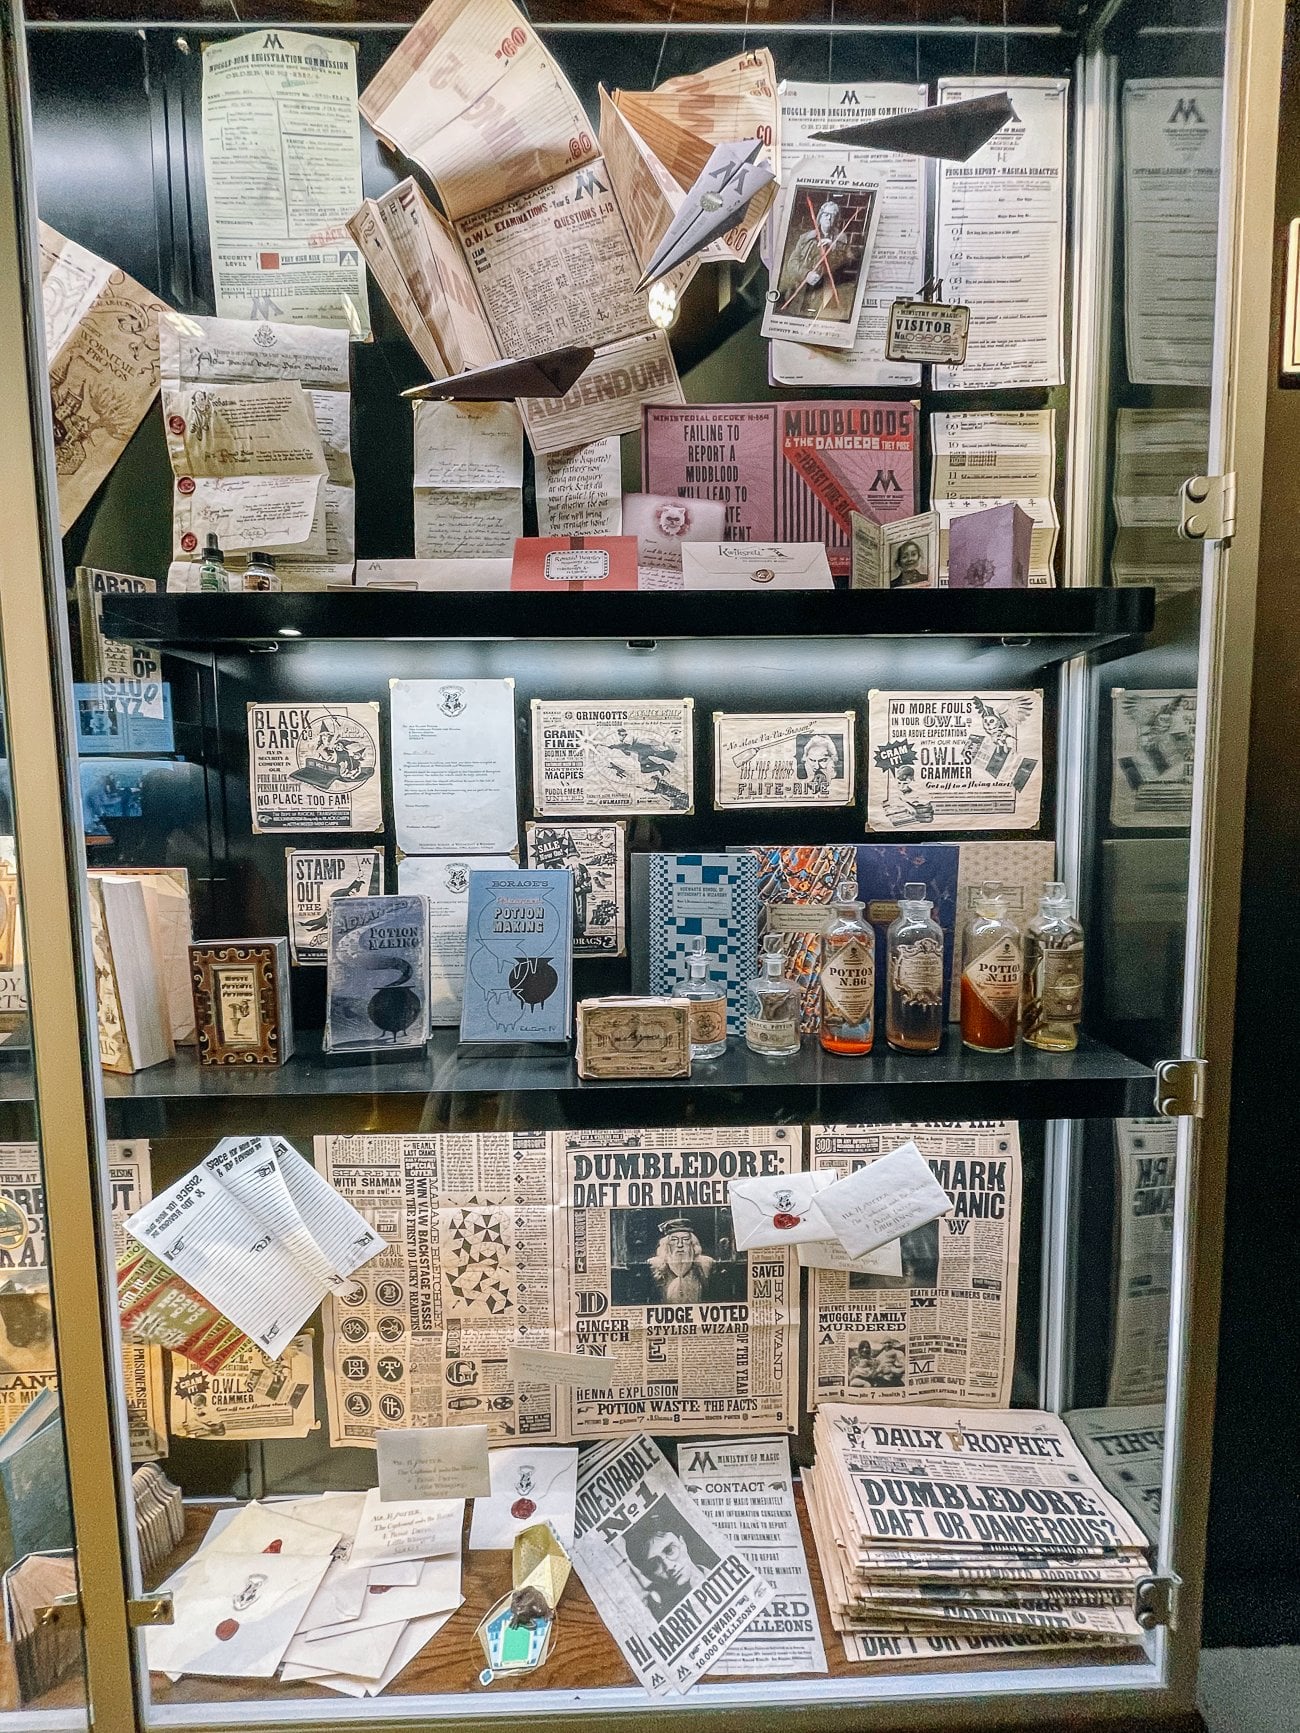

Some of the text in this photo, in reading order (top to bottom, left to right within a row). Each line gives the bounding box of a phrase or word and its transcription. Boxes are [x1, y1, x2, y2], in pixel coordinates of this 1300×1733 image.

[252, 53, 349, 70] REGISTRATION COMMISSION
[828, 108, 876, 117] REGISTRATION
[945, 168, 973, 176] PROGRESS
[797, 178, 836, 186] MINISTRY
[494, 202, 549, 233] EXAMINATIONS
[553, 208, 598, 230] QUESTIONS
[896, 319, 952, 334] VISITOR
[785, 410, 911, 437] MUDBLOODS
[683, 424, 740, 442] FAILING TO
[785, 436, 881, 450] & THE DANGERS
[688, 445, 736, 462] REPORT A
[685, 465, 739, 483] MUDBLOOD
[706, 486, 731, 503] LEAD
[735, 486, 748, 503] TO
[1029, 577, 1048, 585] CLASS
[892, 702, 972, 715] NO MORE FOULS
[254, 710, 312, 730] BLACK
[576, 711, 628, 721] GRINGOTTS
[891, 717, 920, 726] IN YOUR
[255, 730, 299, 749] CARP
[543, 729, 584, 739] GRAND
[908, 729, 926, 737] ABOVE
[927, 729, 967, 738] EXPECTATIONS
[880, 745, 908, 766] CRAM IT!
[544, 771, 584, 780] MAGPIES
[920, 766, 972, 780] CRAMMER
[257, 793, 350, 806] NO PLACE TOO FAR!
[537, 840, 561, 853] SALE
[296, 858, 346, 881] STAMP
[297, 881, 324, 903] OUT
[297, 903, 322, 912] THE
[493, 907, 545, 920] POTION
[369, 926, 419, 939] POTION
[492, 920, 545, 934] MAKING
[829, 966, 873, 977] POTION
[412, 1142, 436, 1150] NEARLY
[573, 1150, 785, 1182] DUMBLEDORE:
[334, 1178, 402, 1187] WITH SHAMAN
[929, 1160, 1006, 1192] MARK
[405, 1178, 415, 1196] FOR
[573, 1183, 621, 1209] DAFT
[627, 1182, 654, 1207] OR
[406, 1198, 417, 1217] THE
[406, 1219, 417, 1246] FIRST
[416, 1178, 433, 1331] WIN BACKSTAGE PASSES
[408, 1261, 419, 1289] LUCKY
[752, 1264, 785, 1278] SAVED
[910, 1289, 981, 1300] DEATH EATER NUMBERS
[409, 1291, 421, 1331] READERS
[646, 1304, 749, 1325] FUDGE VOTED
[818, 1304, 877, 1313] VIOLENCE SPREADS
[818, 1311, 907, 1323] MUGGLE FAMILY
[576, 1319, 629, 1333] GINGER
[646, 1323, 749, 1336] STYLISH WIZARD
[818, 1322, 907, 1333] MURDERED
[576, 1332, 630, 1343] WITCH
[736, 1332, 749, 1396] OF THE YEAR
[133, 1348, 147, 1398] PRISONERS
[576, 1384, 679, 1400] HENNA EXPLOSION
[211, 1394, 255, 1406] CRAMMER
[596, 1401, 646, 1415] POTION
[703, 1400, 725, 1412] THE
[726, 1398, 759, 1411] FACTS
[870, 1426, 944, 1448] DAILY
[945, 1428, 1065, 1458] PROPHET
[717, 1453, 780, 1464] MINISTRY OF MAGIC
[573, 1436, 660, 1540] UNDESIRABLE
[705, 1482, 765, 1493] CONTACT
[859, 1478, 1106, 1517] DUMBLEDORE:
[726, 1510, 760, 1518] INFORMATION
[768, 1521, 788, 1529] REPORT
[869, 1508, 1121, 1546] DAFT OR DANGEROUS?
[759, 1552, 780, 1561] REPORT
[763, 1567, 802, 1575] THE MINISTRY
[648, 1604, 702, 1661] HARRY
[698, 1554, 751, 1614] POTTER
[701, 1607, 738, 1647] REWARD
[717, 1602, 757, 1647] GALLEONS
